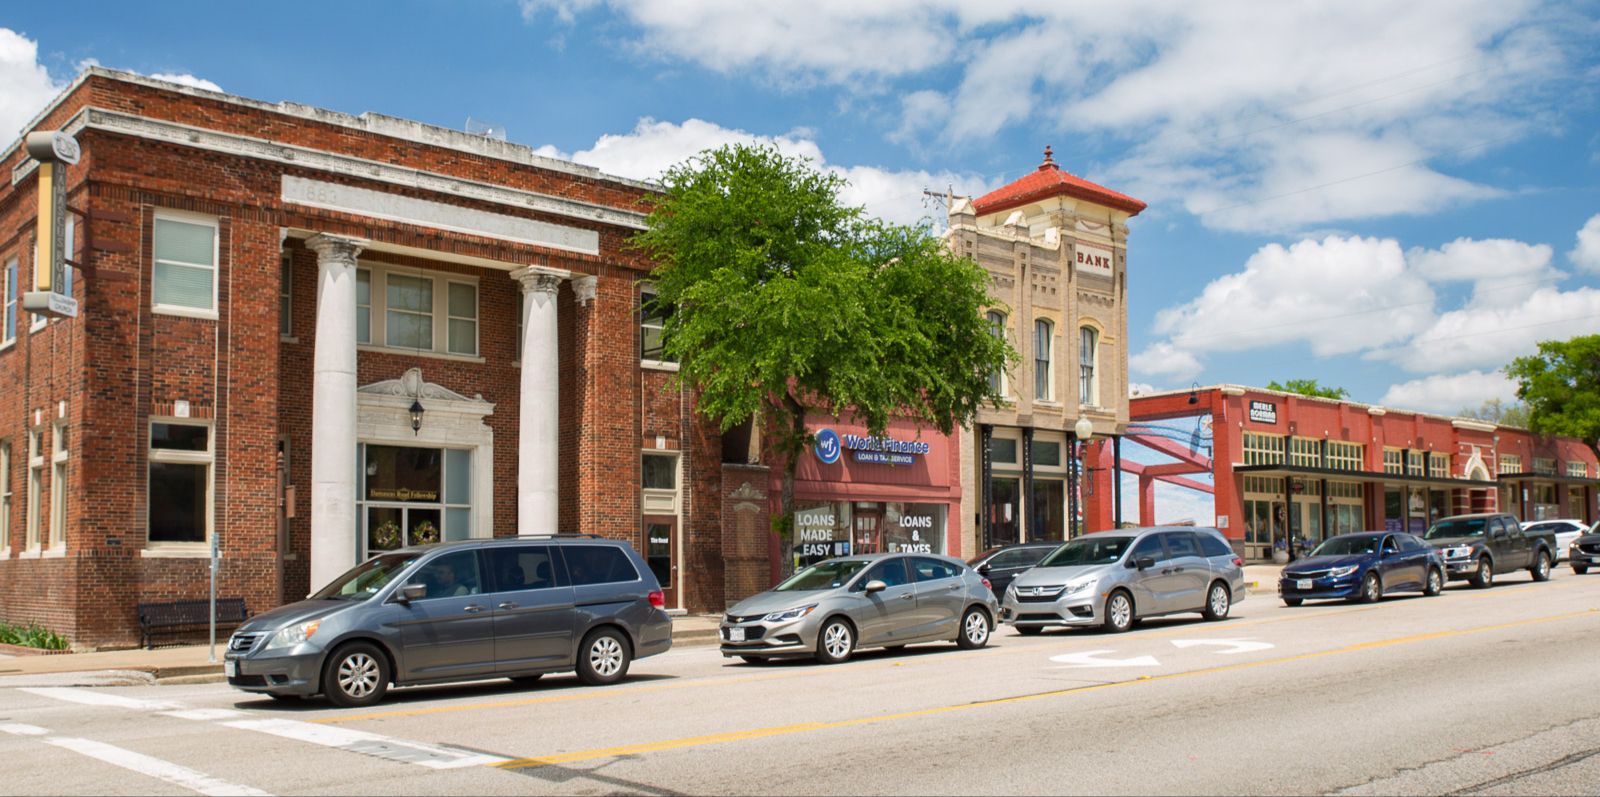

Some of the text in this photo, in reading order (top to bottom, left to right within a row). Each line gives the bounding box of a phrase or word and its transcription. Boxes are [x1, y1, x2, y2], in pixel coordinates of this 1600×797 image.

[1077, 252, 1110, 269] BANK
[56, 250, 65, 294] ROAD
[1253, 402, 1273, 412] MERLE
[843, 434, 929, 454] World Finance
[858, 452, 874, 461] LOAN
[798, 514, 835, 526] LOANS
[899, 515, 932, 528] LOANS
[800, 528, 833, 541] MADE
[912, 529, 920, 542] &
[803, 543, 831, 556] EASY
[900, 543, 931, 555] TAXES
